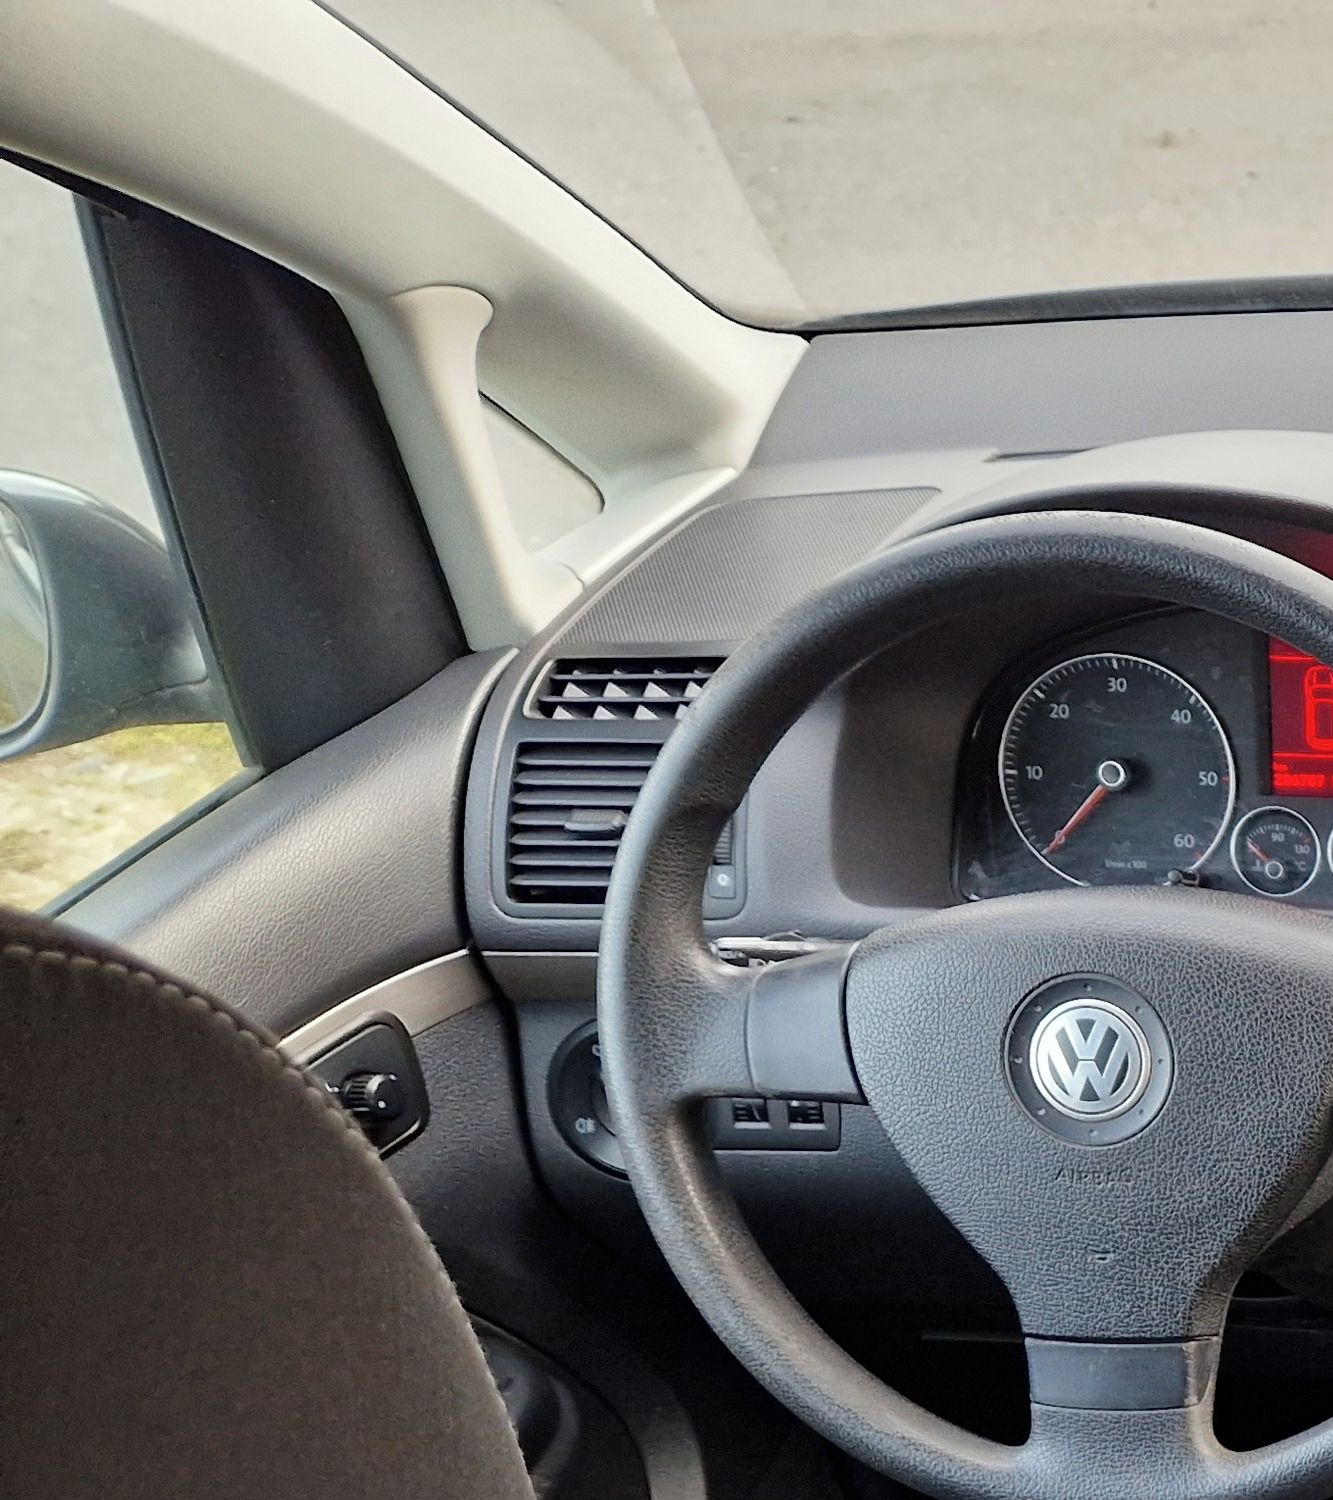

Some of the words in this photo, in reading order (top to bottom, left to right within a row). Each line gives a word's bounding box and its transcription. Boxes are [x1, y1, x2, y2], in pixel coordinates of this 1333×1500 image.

[1107, 677, 1128, 693] 30
[1050, 703, 1070, 719] 20
[1170, 709, 1192, 724] 40
[1025, 765, 1043, 780] 10
[1199, 771, 1218, 786] 50
[1173, 833, 1195, 848] 60
[1271, 833, 1285, 842] 90
[1036, 1004, 1142, 1116] VW
